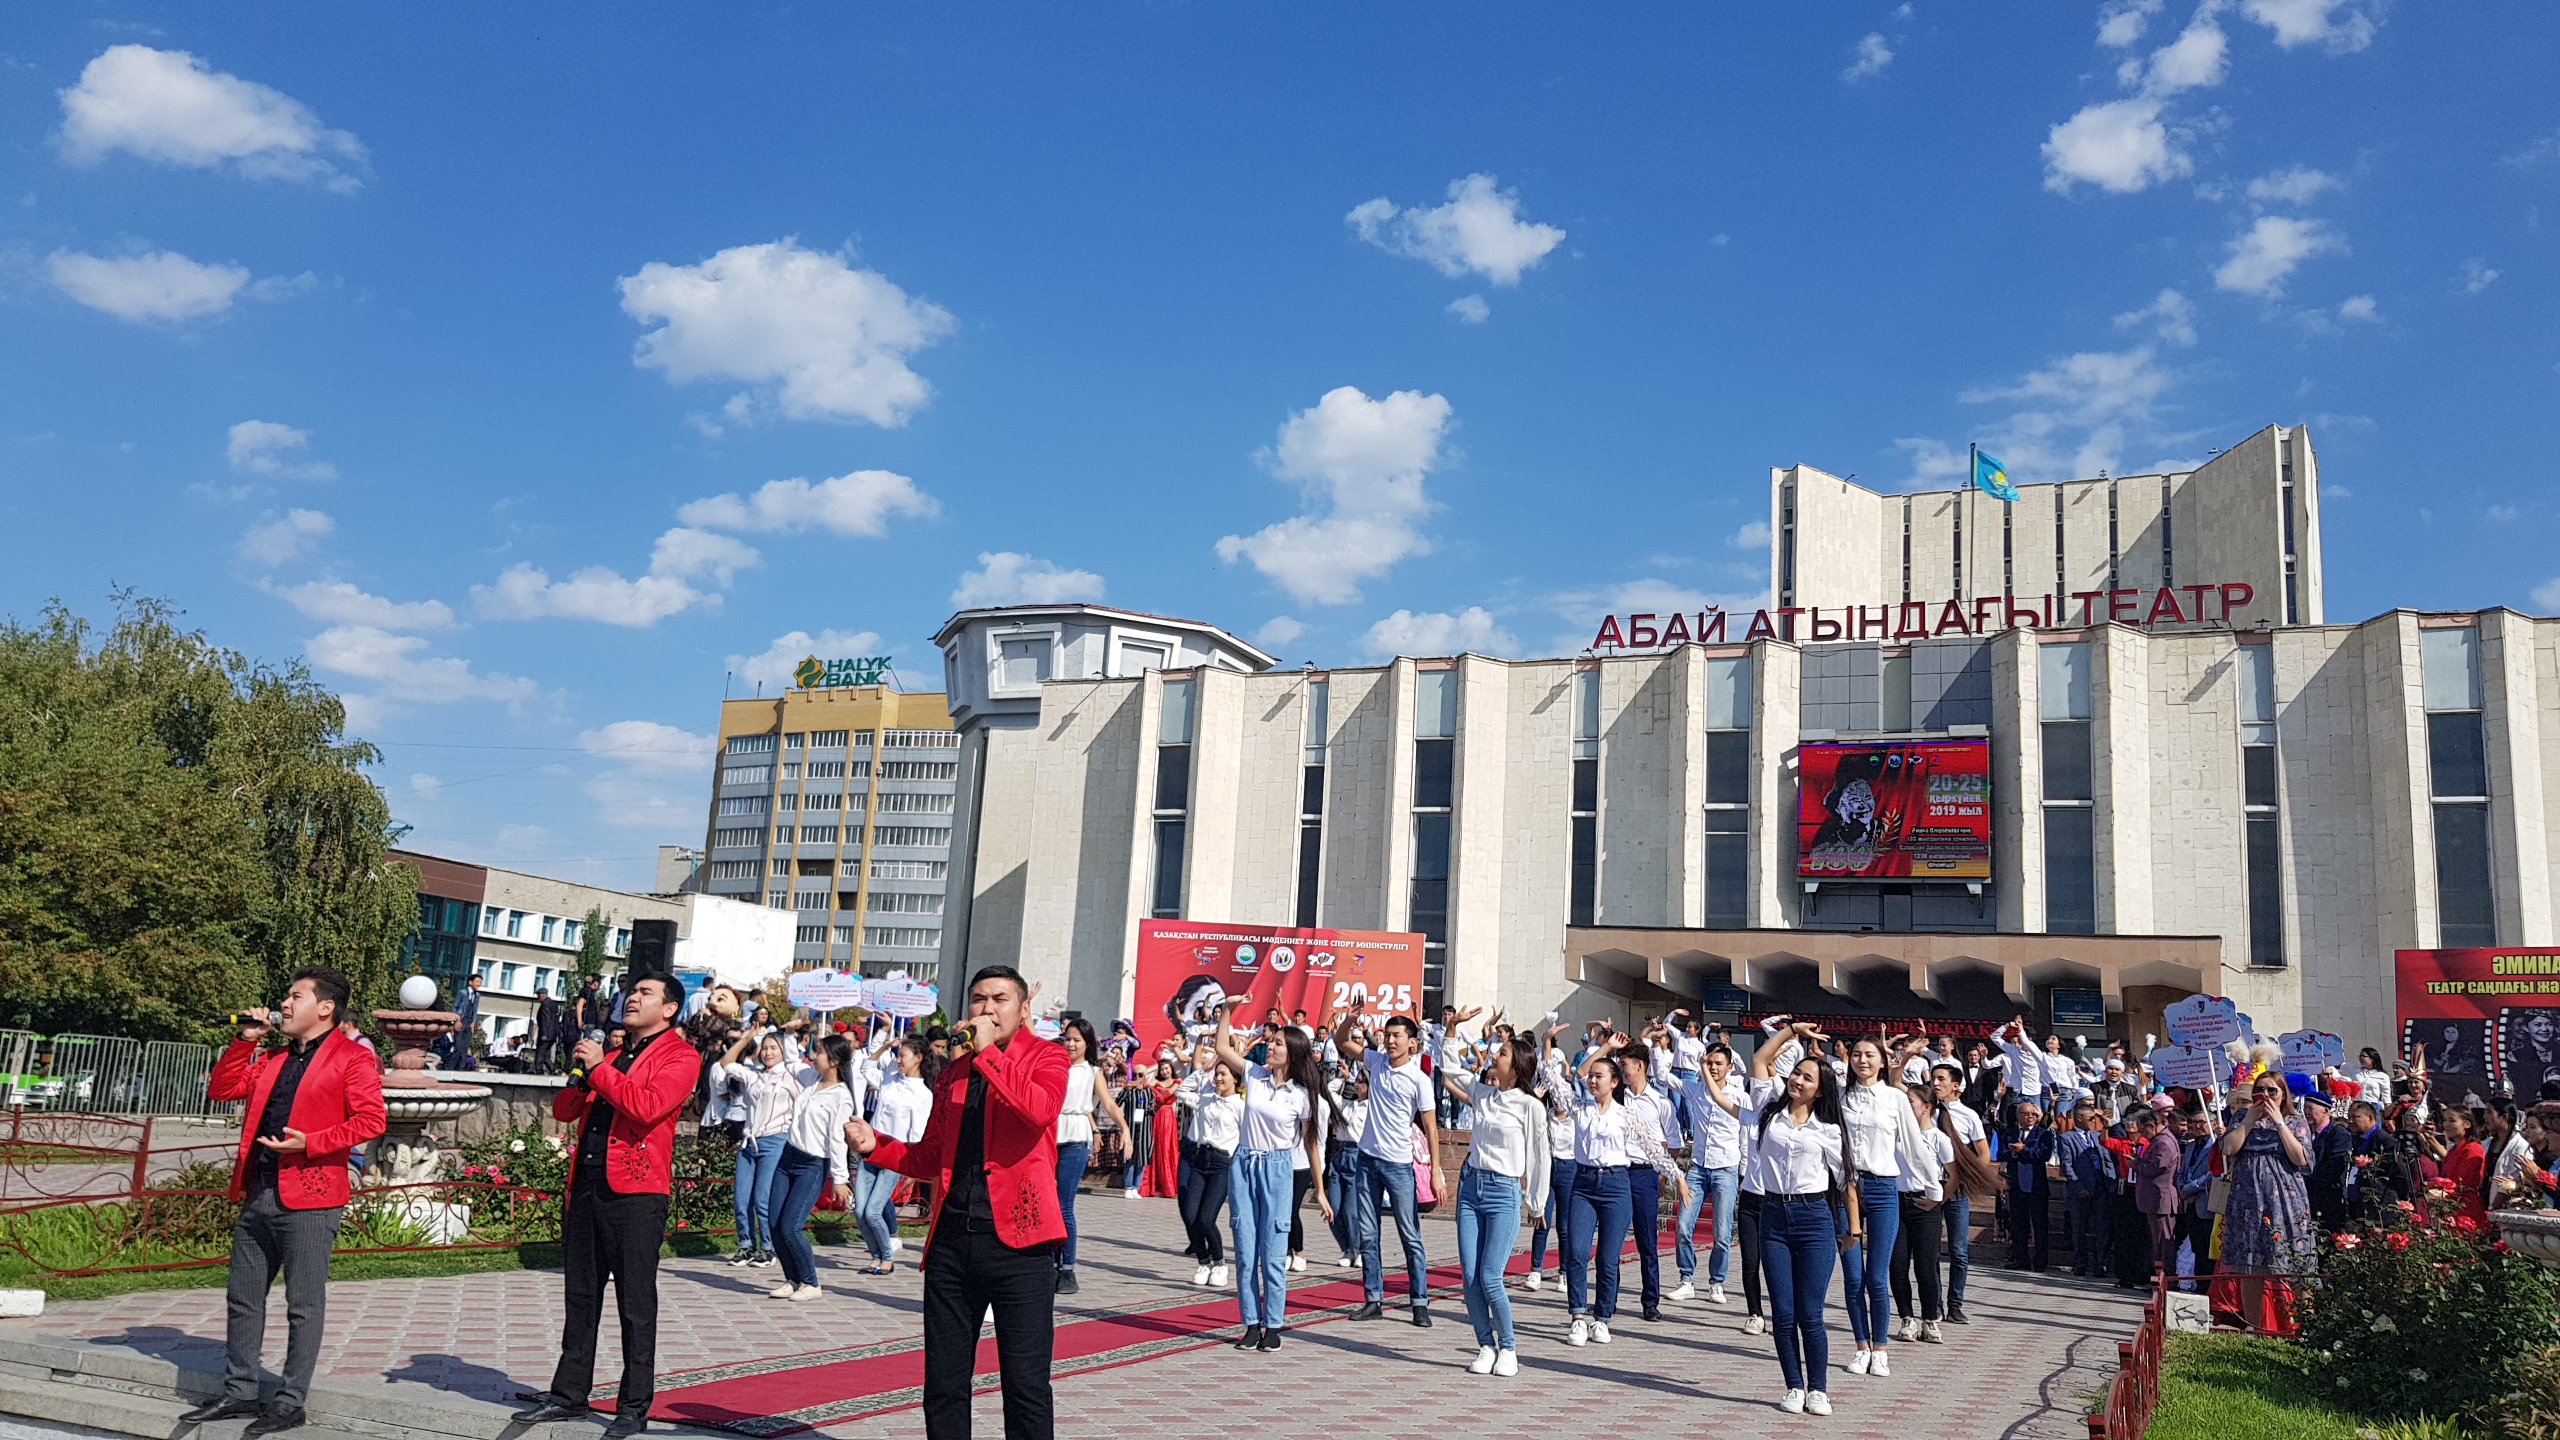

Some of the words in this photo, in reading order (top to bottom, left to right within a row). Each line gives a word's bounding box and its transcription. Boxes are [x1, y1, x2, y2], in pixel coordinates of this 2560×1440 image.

[1593, 603, 1727, 649] АБАЙ
[1746, 594, 2054, 642] АТЫНДАҒЫ
[2072, 582, 2255, 626] ТЕАТР
[828, 656, 892, 673] HALYK
[826, 670, 885, 687] BANK
[1929, 774, 1983, 792] 20-25
[1929, 805, 1956, 816] 2019
[1958, 807, 1983, 816] жыл
[1153, 931, 1198, 940] ҚАЗАҚСТАН
[1199, 932, 1261, 943] РЕСПУБЛИКАСЫ
[1262, 937, 1304, 945] МӘДЕНИЕТ
[1330, 940, 1355, 948] СПОРТ
[1356, 942, 1409, 950] МИНИСТРЛІГІ
[1332, 981, 1412, 1012] 20-25
[2426, 982, 2465, 994] ТЕАТР
[2467, 981, 2534, 995] САҢЛАҒЫ
[2537, 981, 2560, 993] ЖӘ
